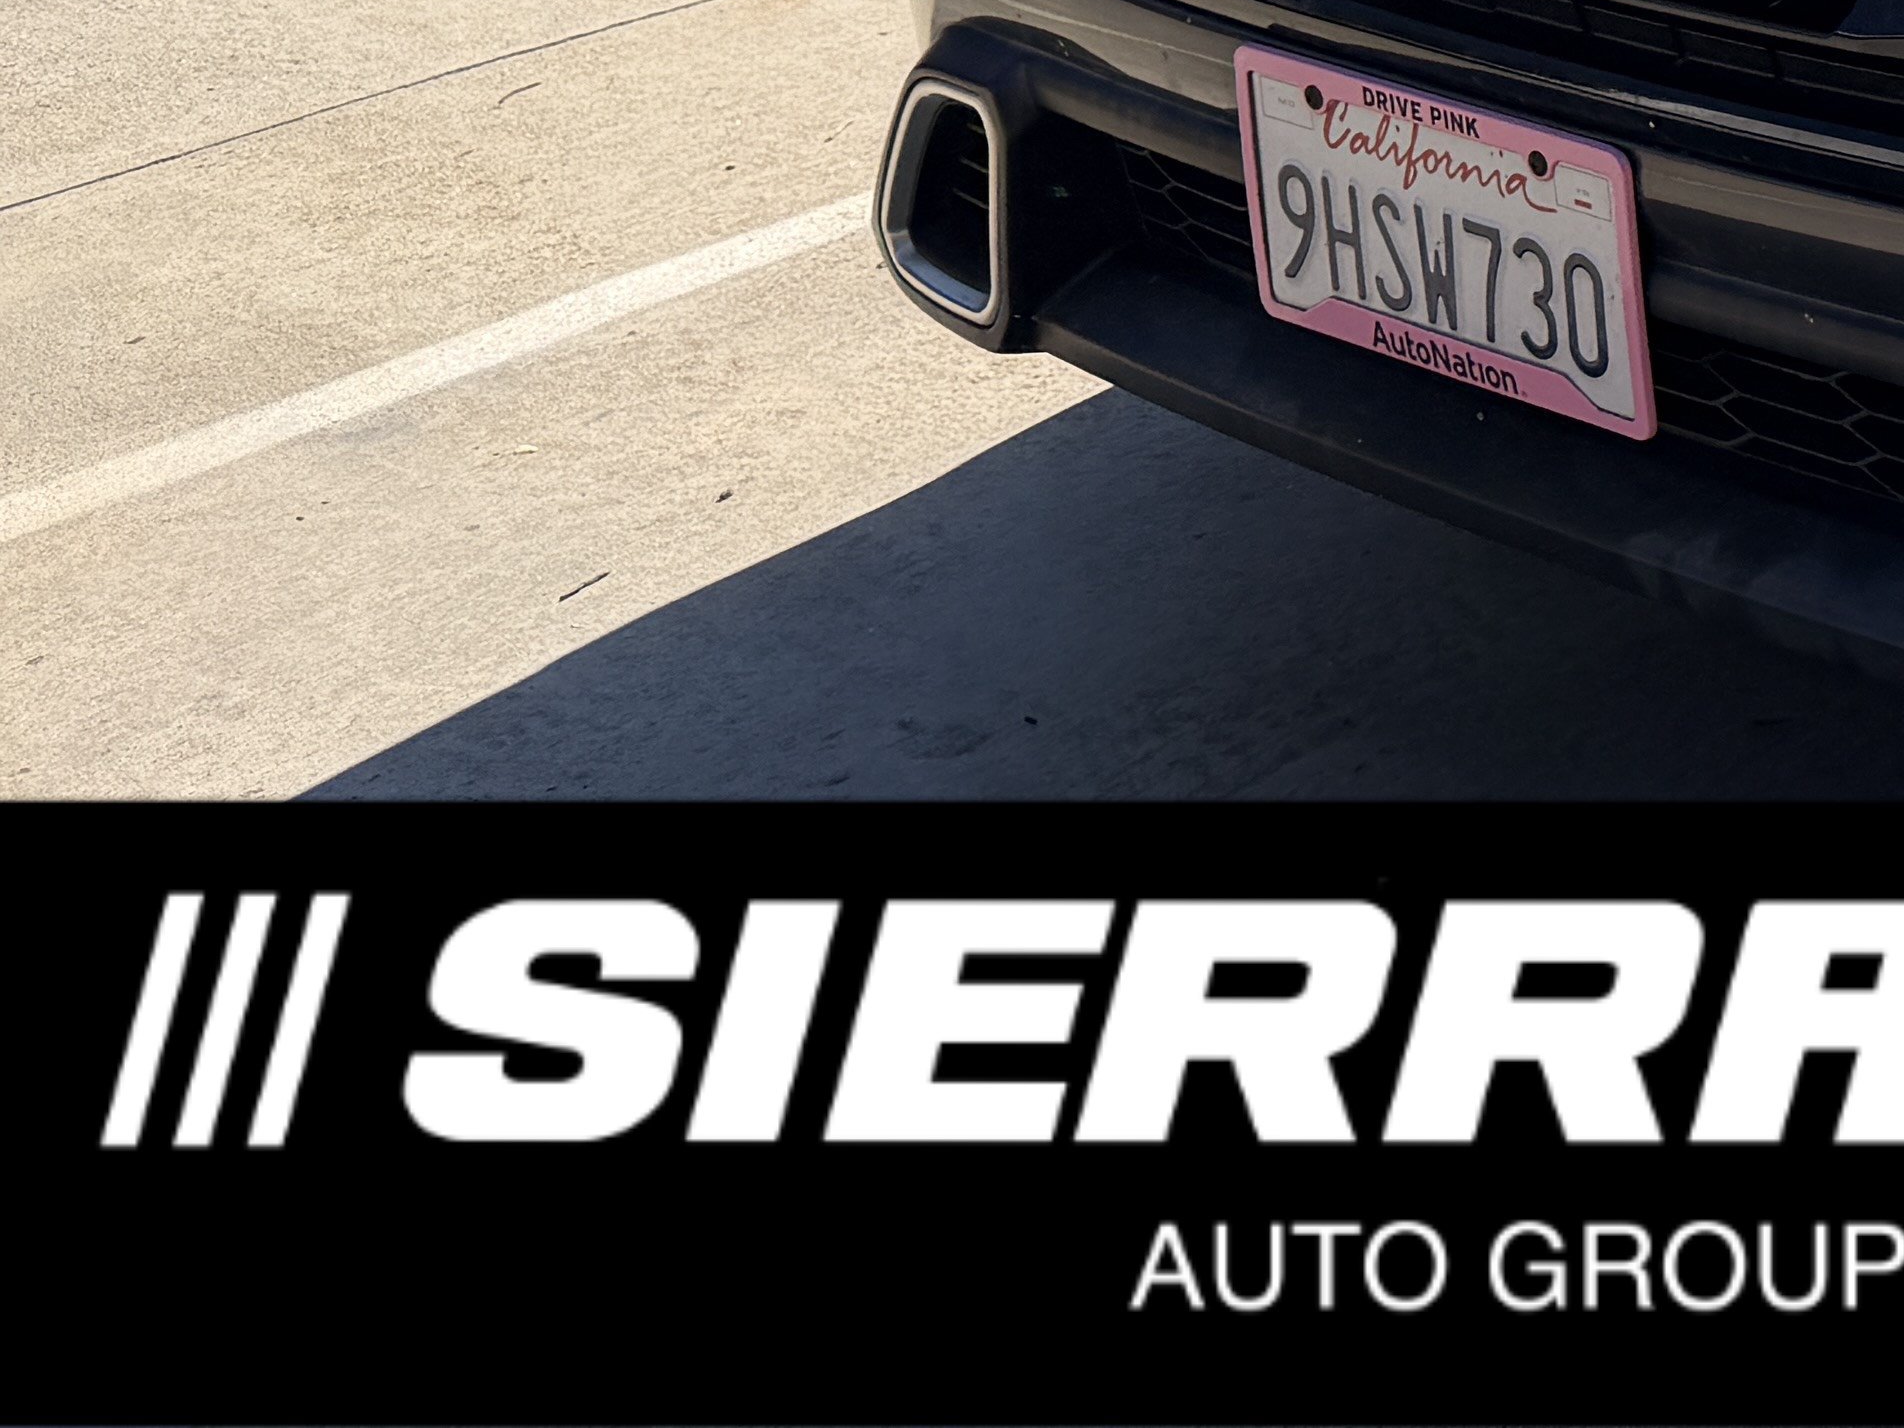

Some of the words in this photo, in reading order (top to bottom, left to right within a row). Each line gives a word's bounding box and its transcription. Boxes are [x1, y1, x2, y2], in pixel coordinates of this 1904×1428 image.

[1322, 99, 1557, 214] California
[1362, 85, 1424, 122] DRIVE
[1429, 105, 1481, 140] PINK
[1278, 164, 1609, 379] 9HSW730
[1373, 320, 1519, 396] AutoNation
